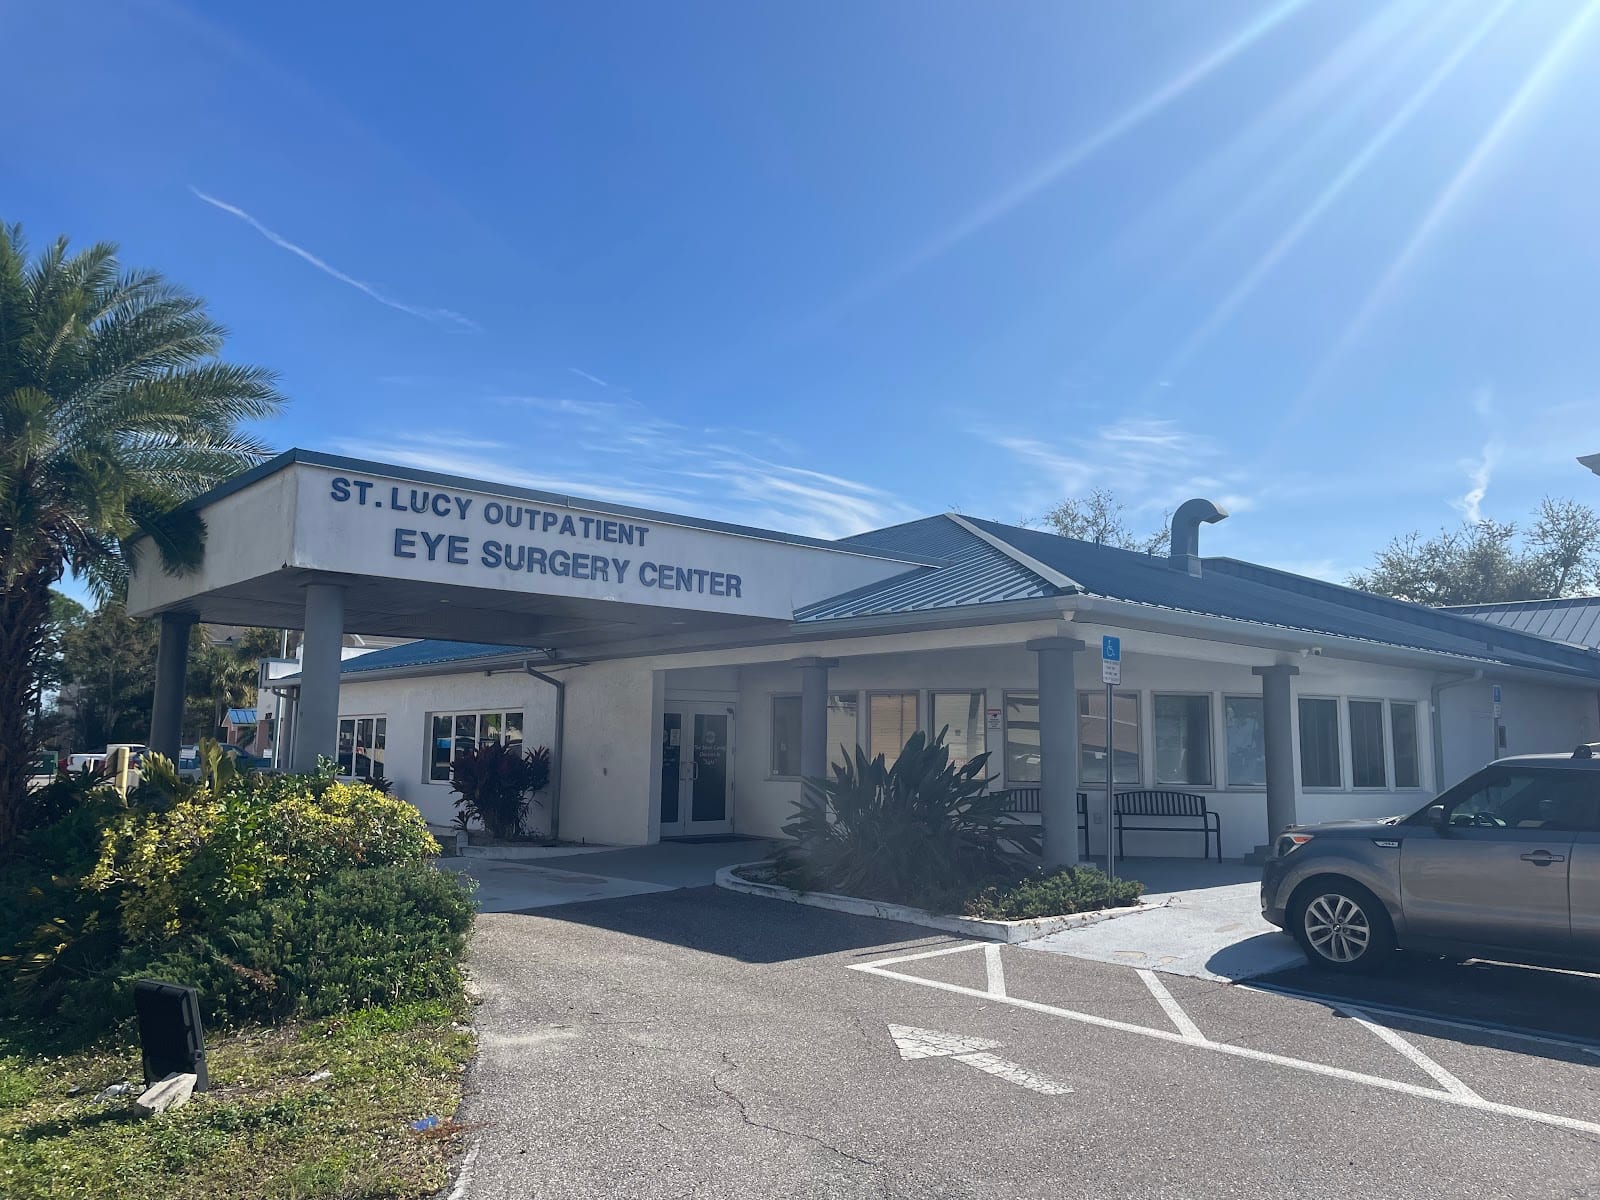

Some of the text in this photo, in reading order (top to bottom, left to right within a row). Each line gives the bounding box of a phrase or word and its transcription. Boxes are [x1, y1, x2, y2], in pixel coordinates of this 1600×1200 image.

[391, 487, 473, 520] LUCY
[484, 502, 650, 547] OUTPATIENT
[394, 528, 742, 599] EYE SURGERY CENTER
